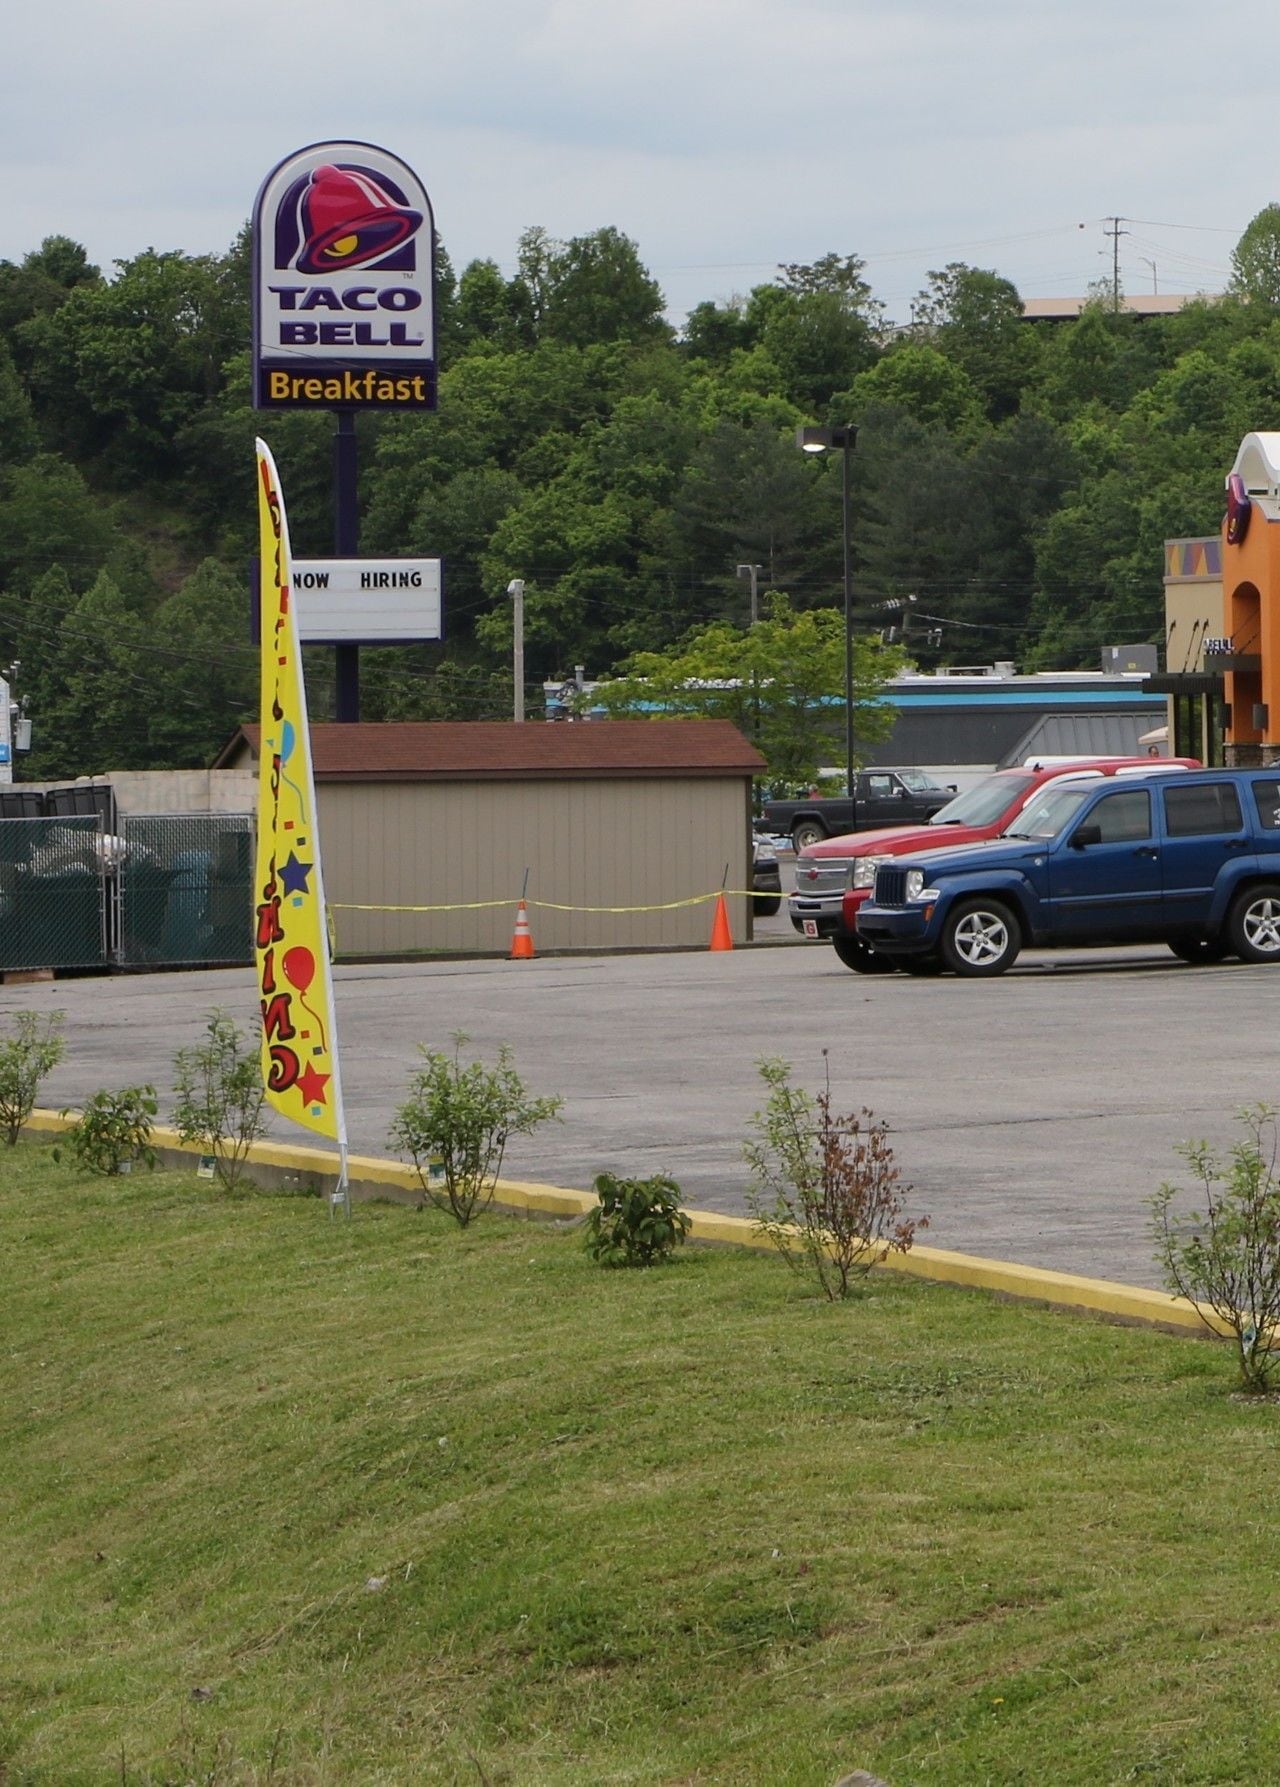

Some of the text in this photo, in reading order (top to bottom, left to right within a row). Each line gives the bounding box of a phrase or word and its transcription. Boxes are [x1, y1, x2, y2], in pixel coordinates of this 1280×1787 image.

[267, 286, 422, 311] TACO
[279, 321, 425, 346] BELL
[270, 371, 425, 400] Breakfast
[292, 572, 422, 589] NOW HIRING
